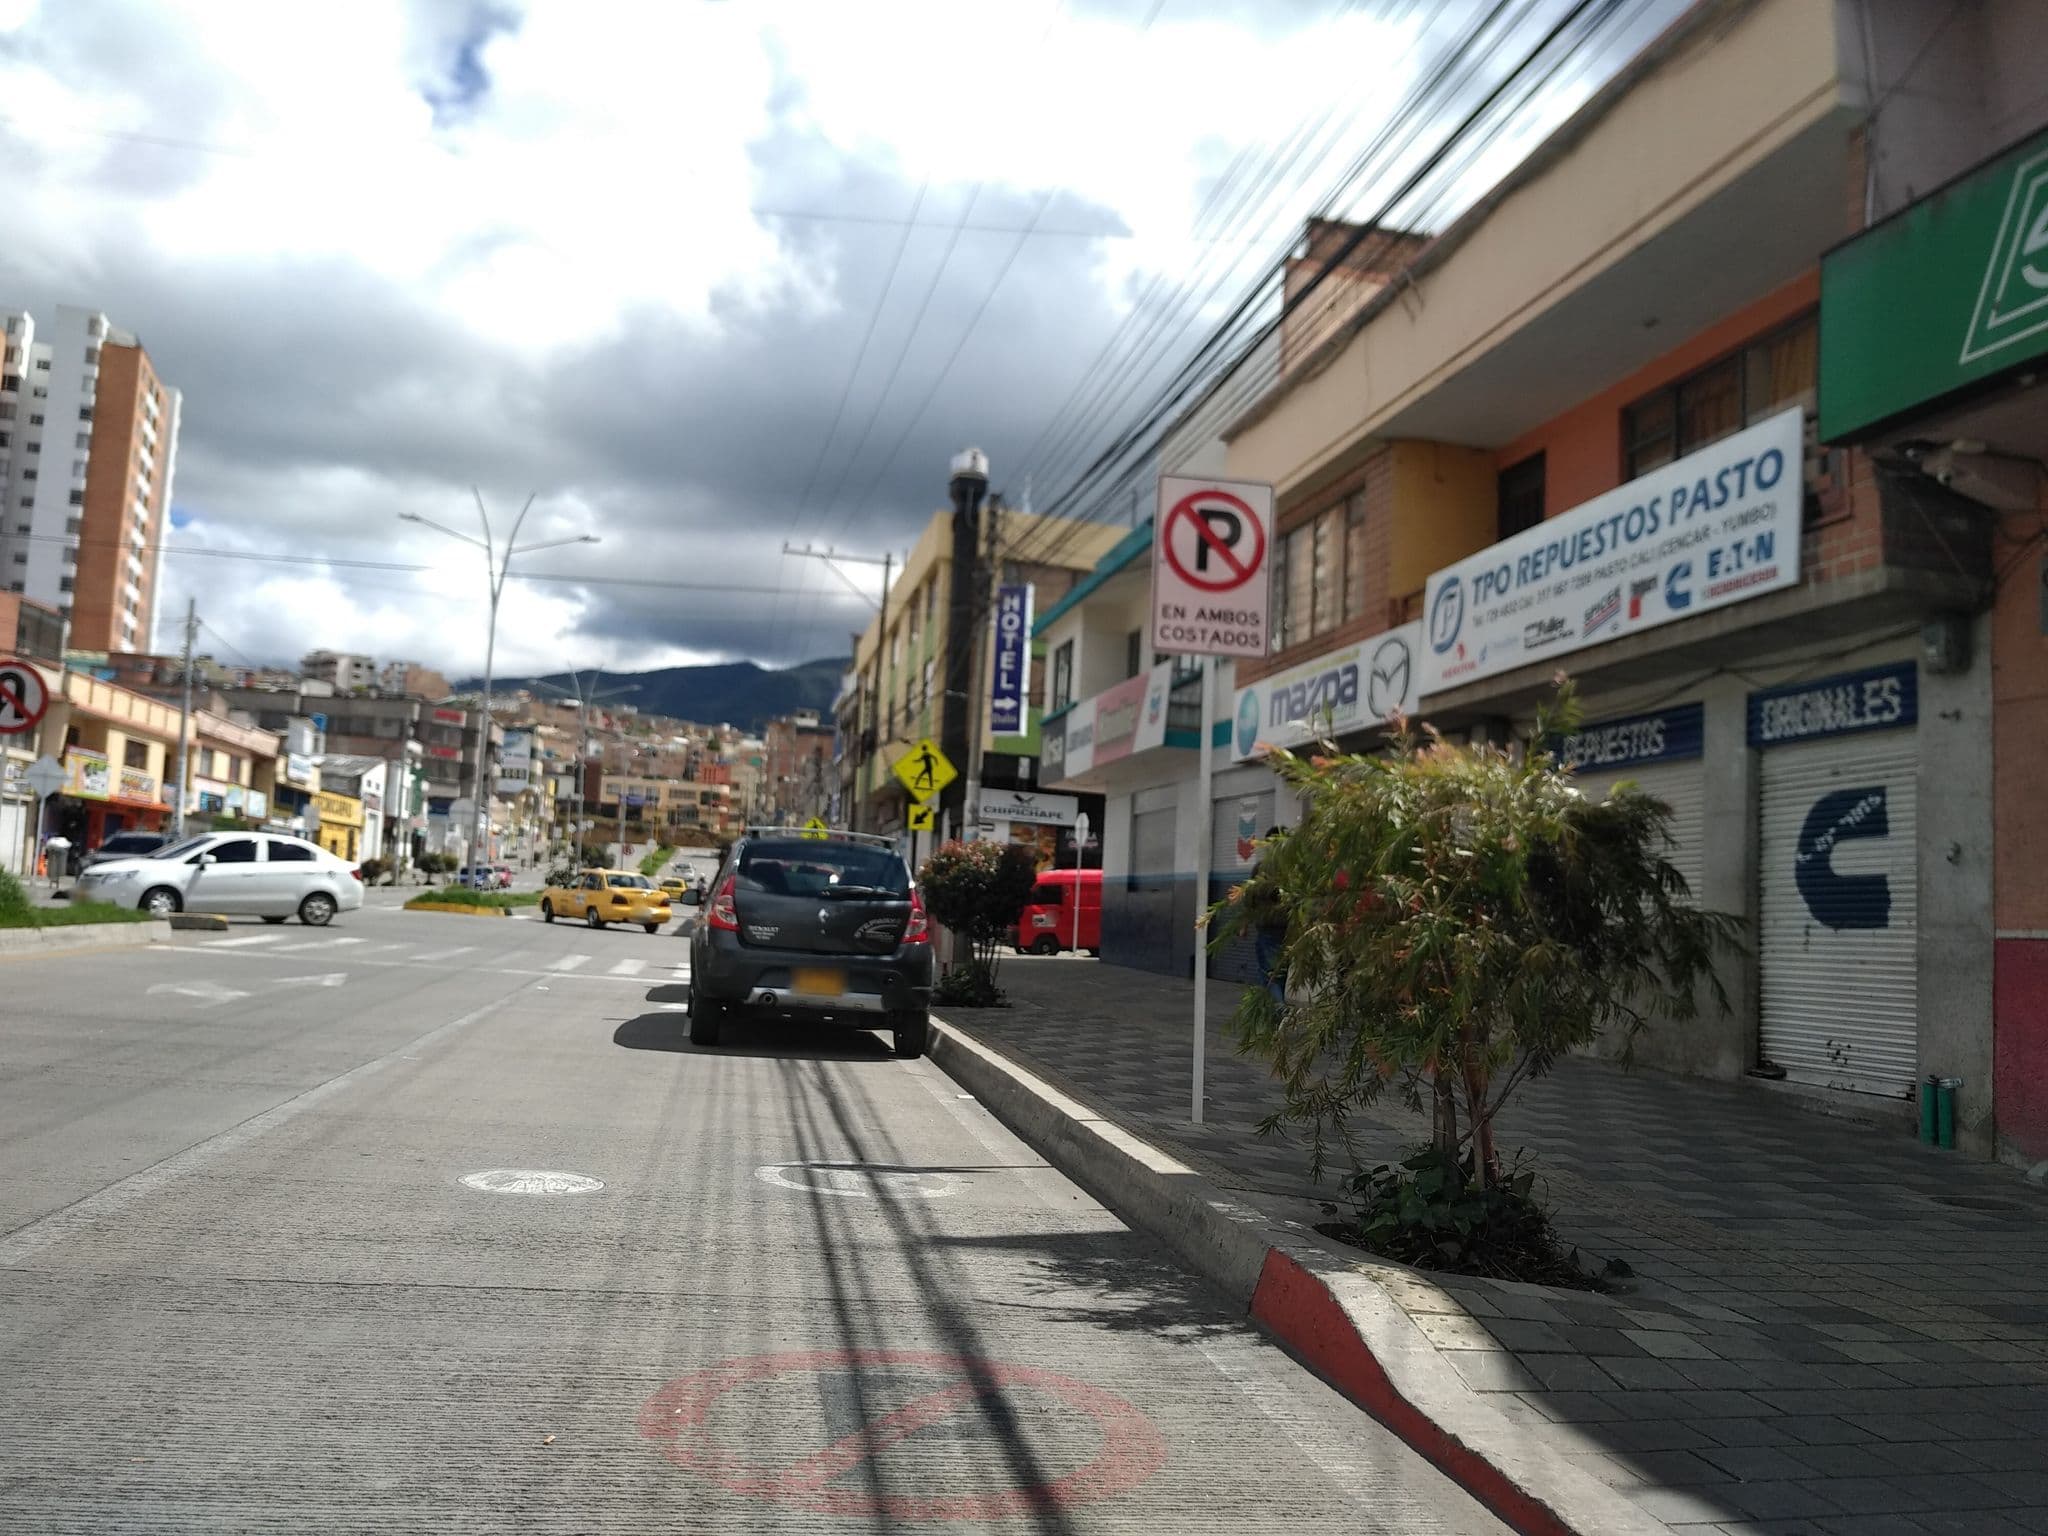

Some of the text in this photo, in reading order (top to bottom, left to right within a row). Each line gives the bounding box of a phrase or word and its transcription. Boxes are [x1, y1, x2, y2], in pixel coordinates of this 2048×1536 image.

[1195, 508, 1242, 572] P
[1472, 563, 1510, 606] TPO
[1516, 497, 1660, 588] REPUESTOS
[1669, 447, 1784, 524] PASTO
[999, 594, 1021, 691] HOTEL
[1159, 625, 1261, 648] COSTADOS
[1161, 603, 1261, 626] EN AMBOS
[1268, 662, 1359, 728] mazda
[1760, 676, 1902, 741] ORIGINALES
